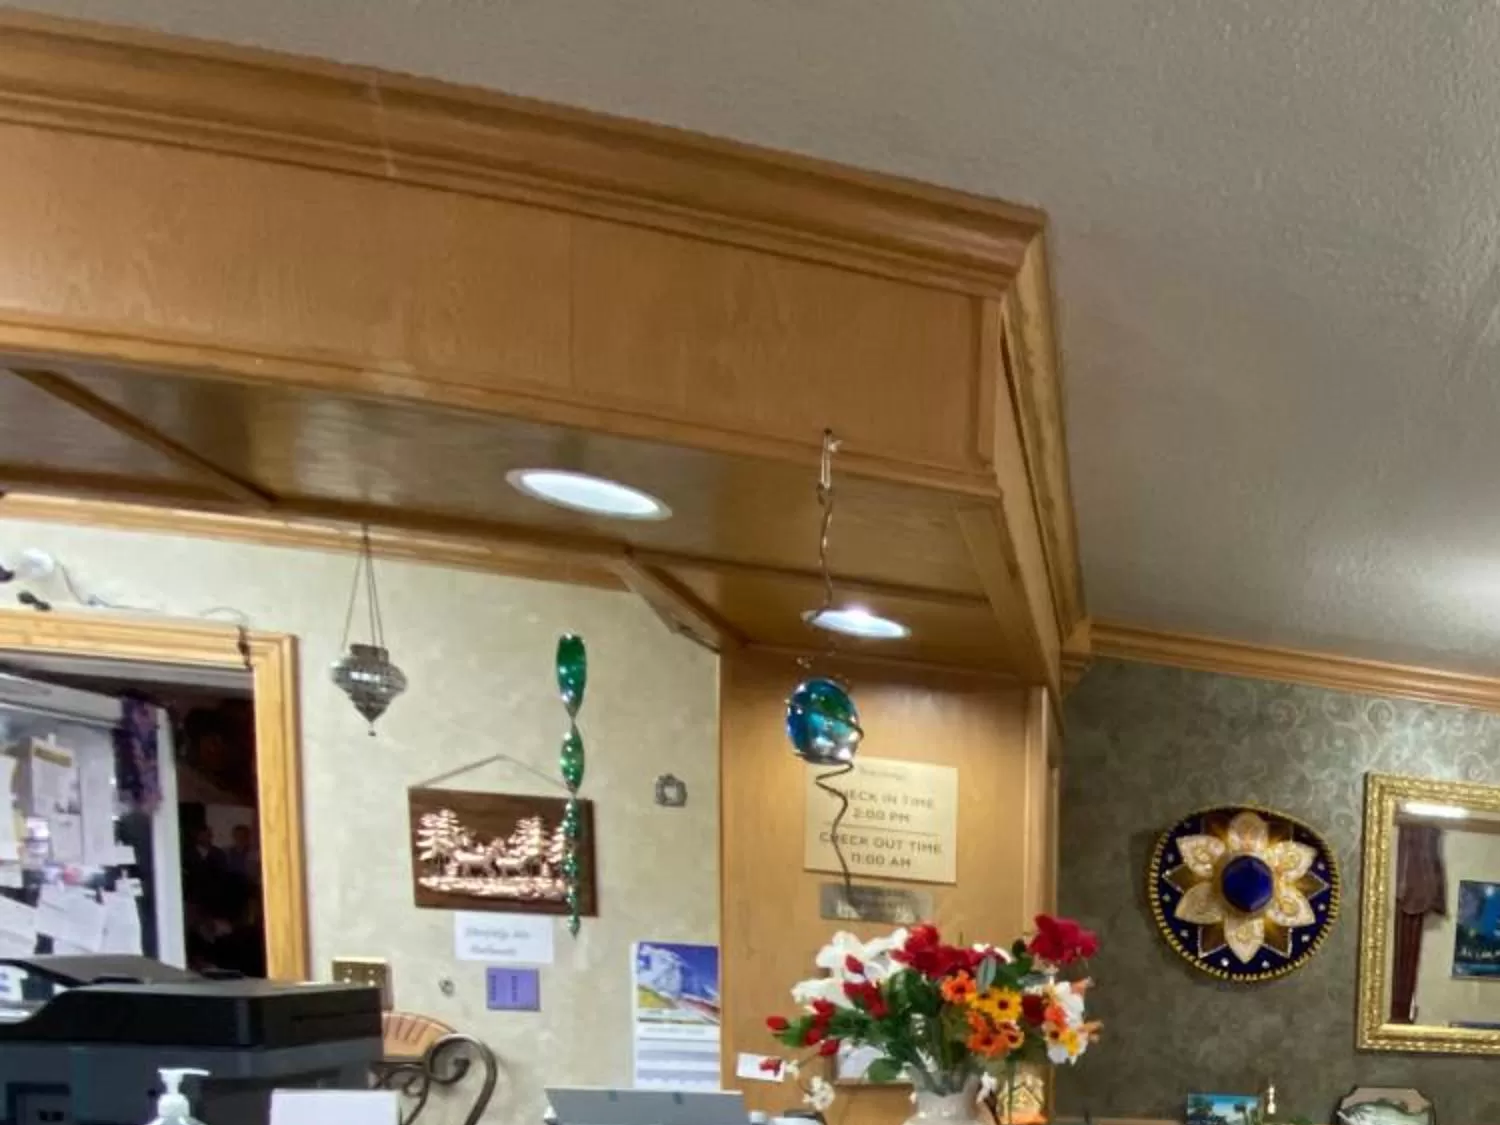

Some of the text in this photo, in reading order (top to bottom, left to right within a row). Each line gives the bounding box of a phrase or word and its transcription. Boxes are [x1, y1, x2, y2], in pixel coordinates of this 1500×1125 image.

[829, 788, 934, 809] ECK IN TIME
[889, 811, 910, 824] PM
[873, 835, 904, 850] OUT
[909, 841, 942, 855] TIME
[851, 853, 911, 868] 11:00 AM
